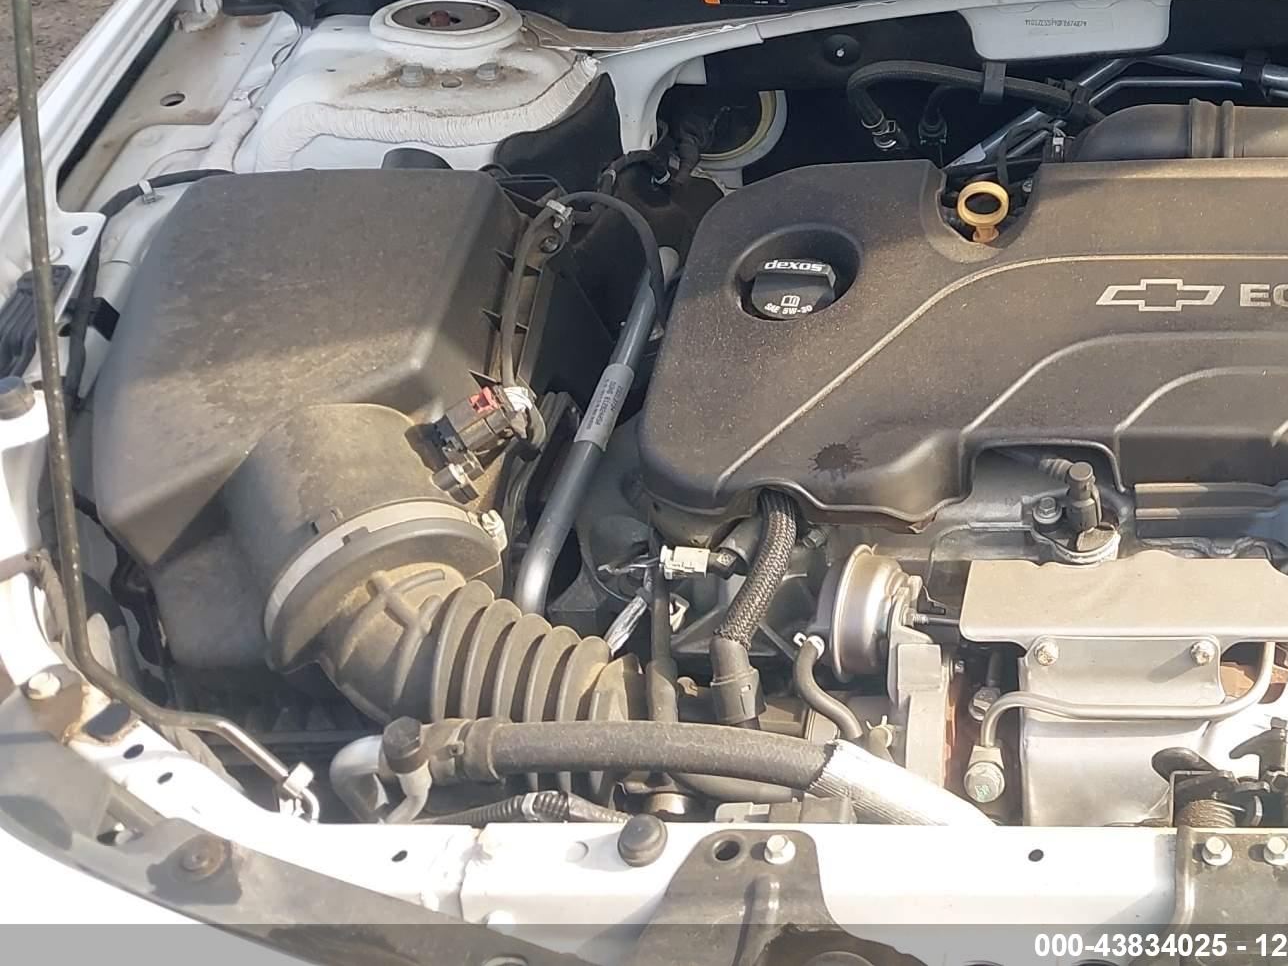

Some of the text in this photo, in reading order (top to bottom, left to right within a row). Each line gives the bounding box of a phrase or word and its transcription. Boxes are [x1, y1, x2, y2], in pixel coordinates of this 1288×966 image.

[764, 260, 826, 272] dexos
[764, 302, 813, 315] SAE 5W-30
